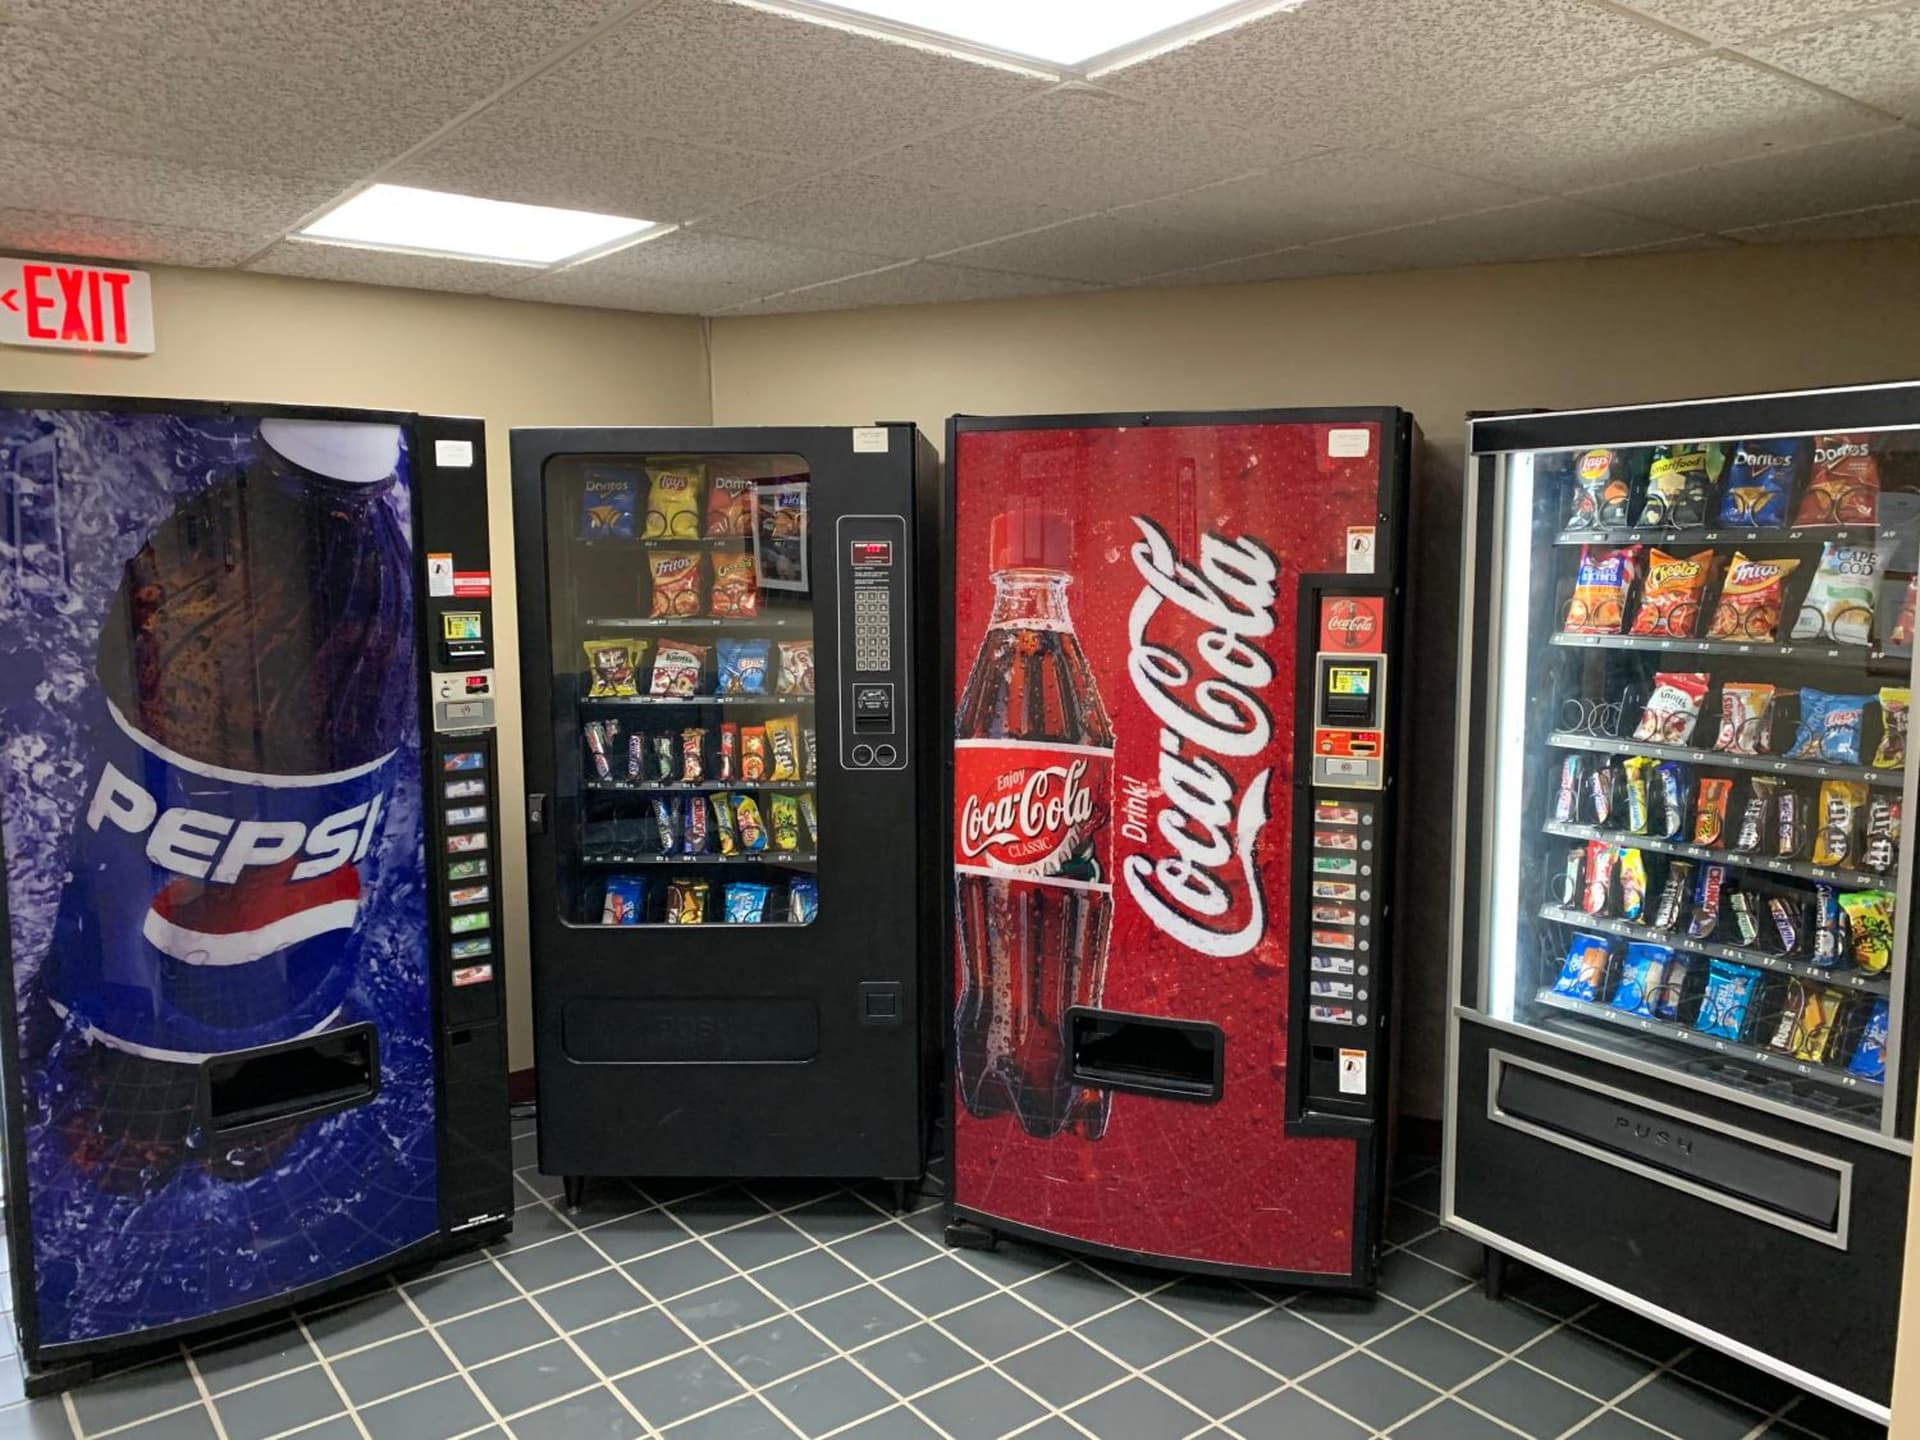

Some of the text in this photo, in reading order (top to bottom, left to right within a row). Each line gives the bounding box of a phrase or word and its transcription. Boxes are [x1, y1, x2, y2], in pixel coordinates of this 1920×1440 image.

[23, 264, 130, 345] EXIT
[1734, 451, 1792, 466] Doritos
[1813, 443, 1869, 464] Doritos
[585, 480, 628, 492] Doritos
[715, 478, 758, 491] Doritos
[1837, 550, 1879, 566] CAPE
[1839, 562, 1873, 576] COD
[1328, 615, 1374, 631] Coca-Cola
[1123, 514, 1278, 957] Coca-Cola
[997, 768, 1025, 791] Enjoy
[961, 757, 1093, 857] Coca-Cola
[1121, 775, 1148, 843] Drink!
[86, 761, 384, 883] PEPSI
[1008, 837, 1052, 858] CLASSIC
[1614, 1116, 1694, 1155] PUSH
